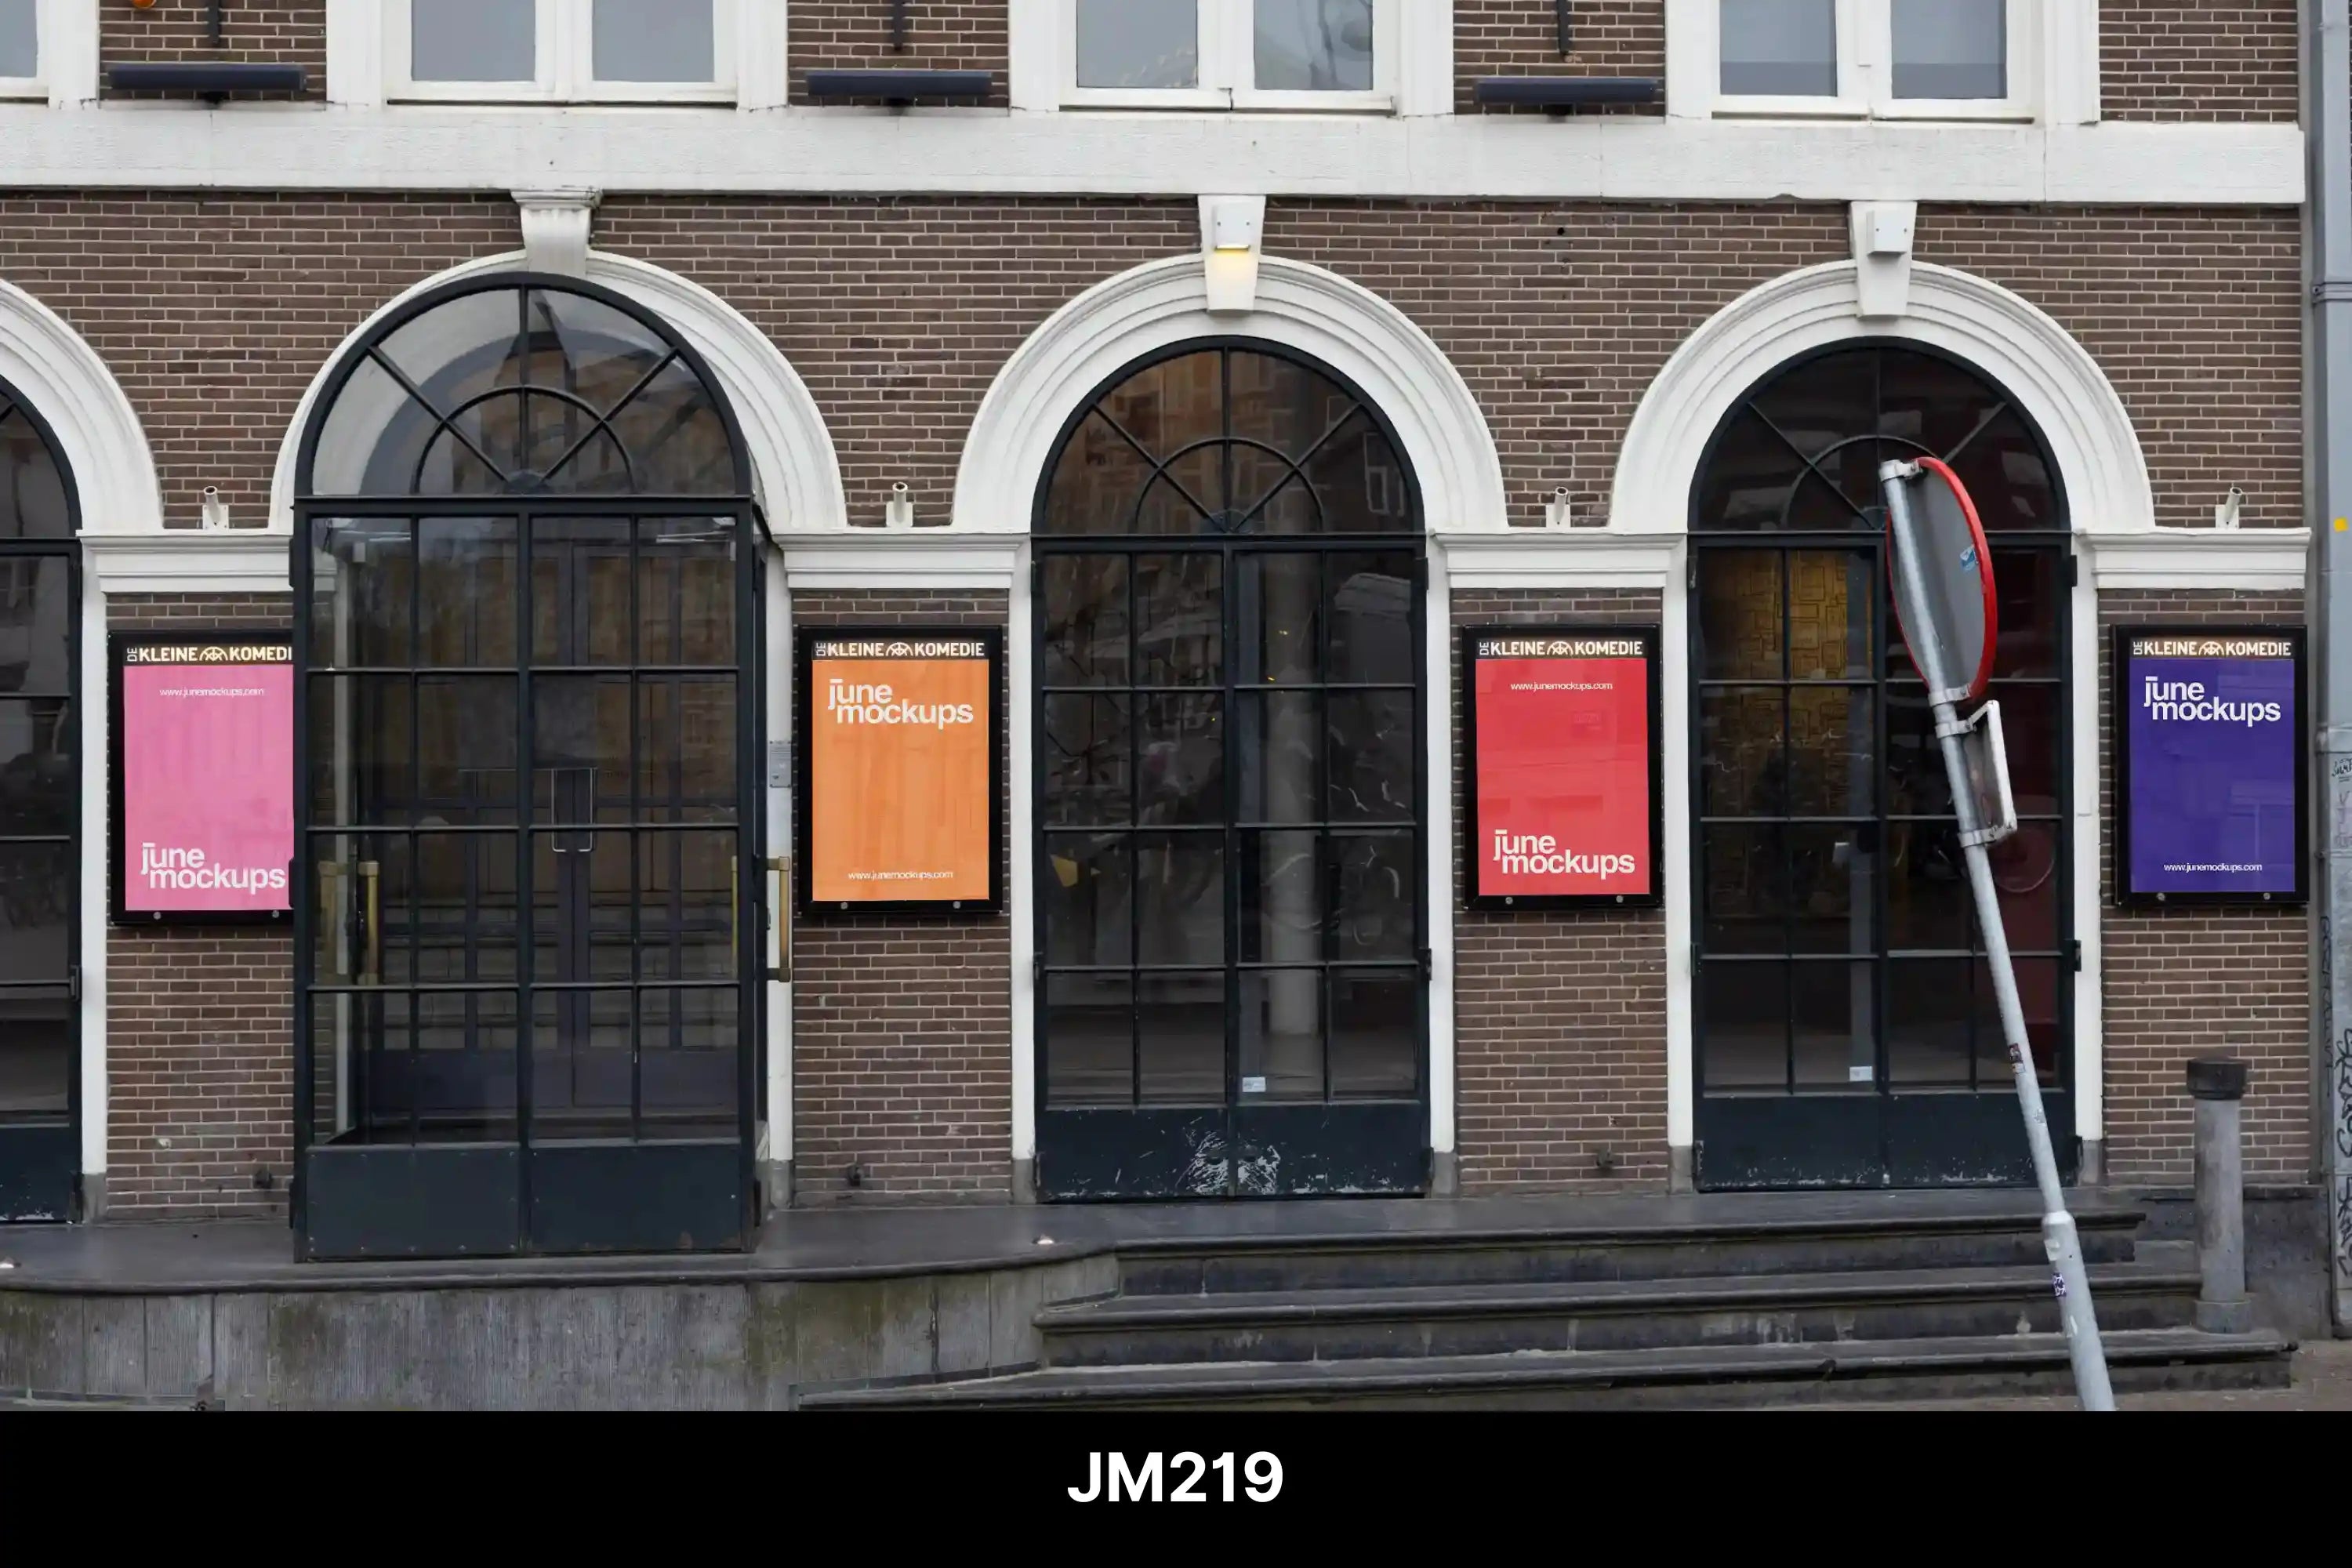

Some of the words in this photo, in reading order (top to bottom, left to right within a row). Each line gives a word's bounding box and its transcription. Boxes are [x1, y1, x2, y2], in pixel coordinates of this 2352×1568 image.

[127, 648, 137, 662] DE
[139, 647, 198, 662] KLEINE
[229, 646, 292, 661] KOMEDI
[816, 643, 826, 656] DE
[827, 642, 884, 657] KLEINE
[914, 642, 985, 657] KOMEDIE
[1479, 641, 1490, 655] DE
[1490, 641, 1545, 655] KLEINE
[1574, 641, 1642, 655] KOMEDIE
[2133, 641, 2143, 655] DE
[2144, 641, 2197, 655] KLEINE
[2226, 641, 2291, 655] KOMEDIE
[159, 688, 264, 698] www.junemockups.com
[828, 678, 893, 710] june
[1510, 681, 1613, 692] www.junemockups.com
[2143, 676, 2205, 707] june
[837, 699, 974, 730] mockups
[2152, 696, 2281, 728] mockups
[141, 842, 205, 874] june
[1493, 829, 1556, 861] june
[150, 863, 285, 895] mockups
[1502, 849, 1635, 880] mockups
[2163, 863, 2262, 873] www.junemockups.com
